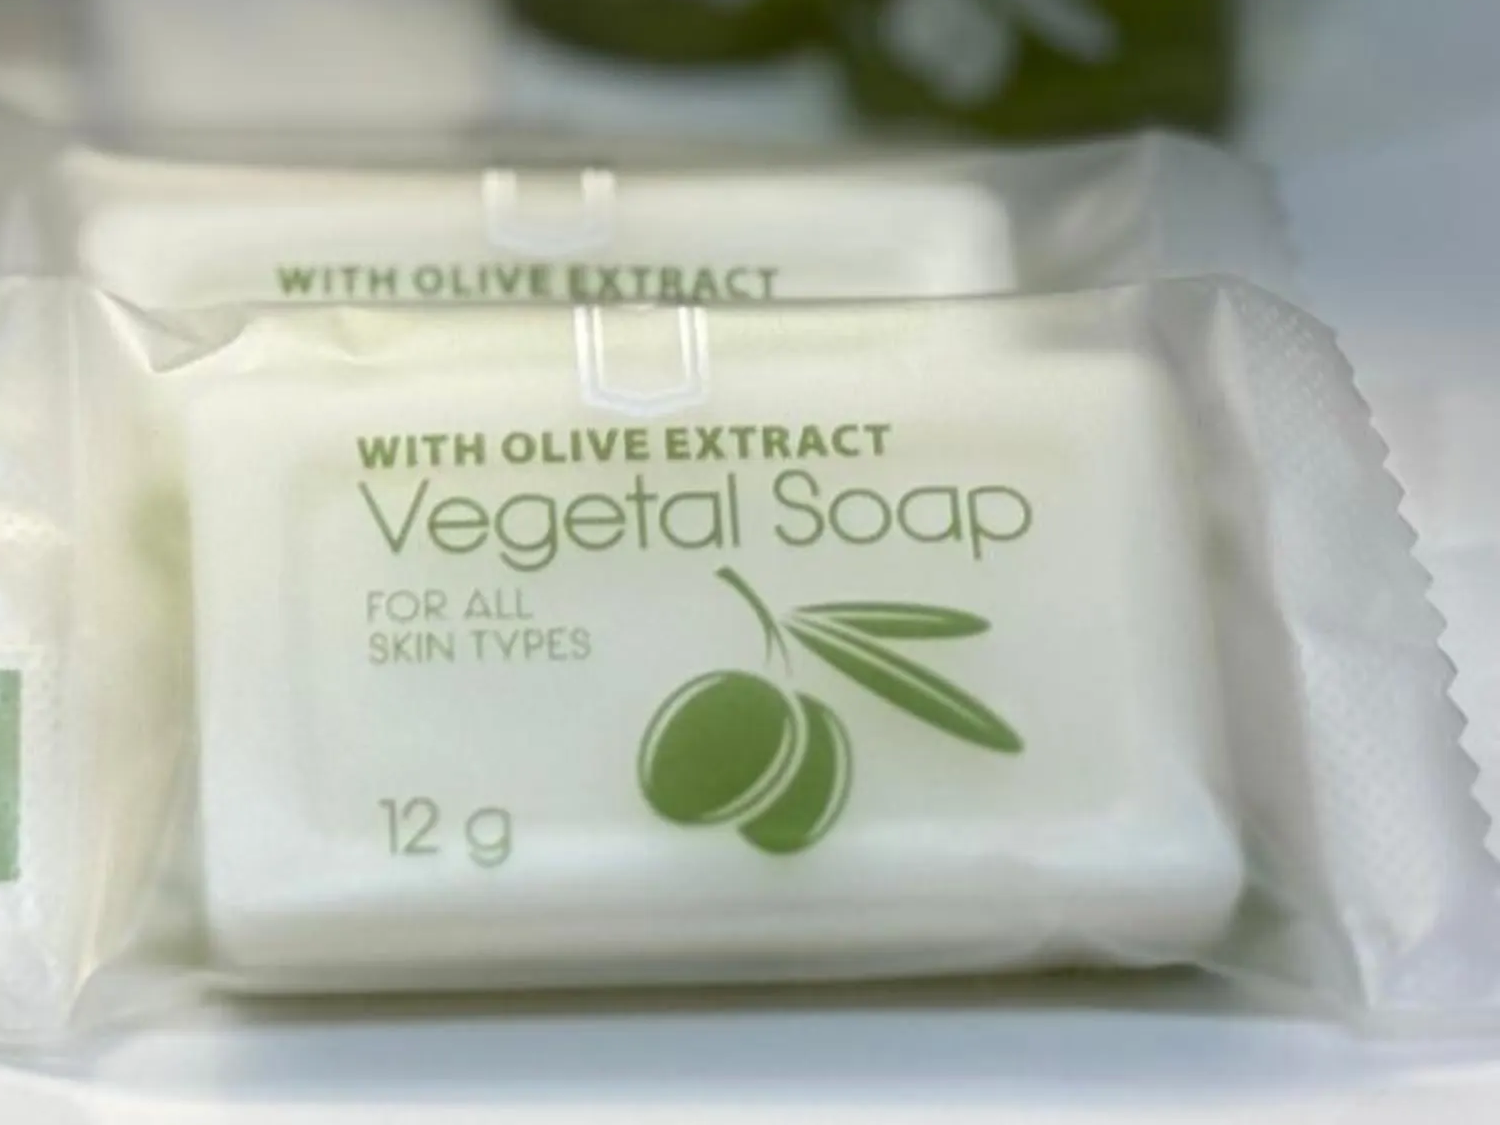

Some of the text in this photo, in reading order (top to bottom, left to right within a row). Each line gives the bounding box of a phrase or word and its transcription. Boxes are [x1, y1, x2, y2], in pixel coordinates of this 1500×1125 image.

[277, 264, 779, 302] WITH OLIVE EXTRACT
[357, 424, 892, 469] WITH OLIVE EXTRACT
[358, 469, 1033, 572] Vegetal Soap
[366, 589, 534, 623] FOR ALL
[368, 627, 592, 664] SKIN TYPES
[378, 796, 513, 868] 12 g
